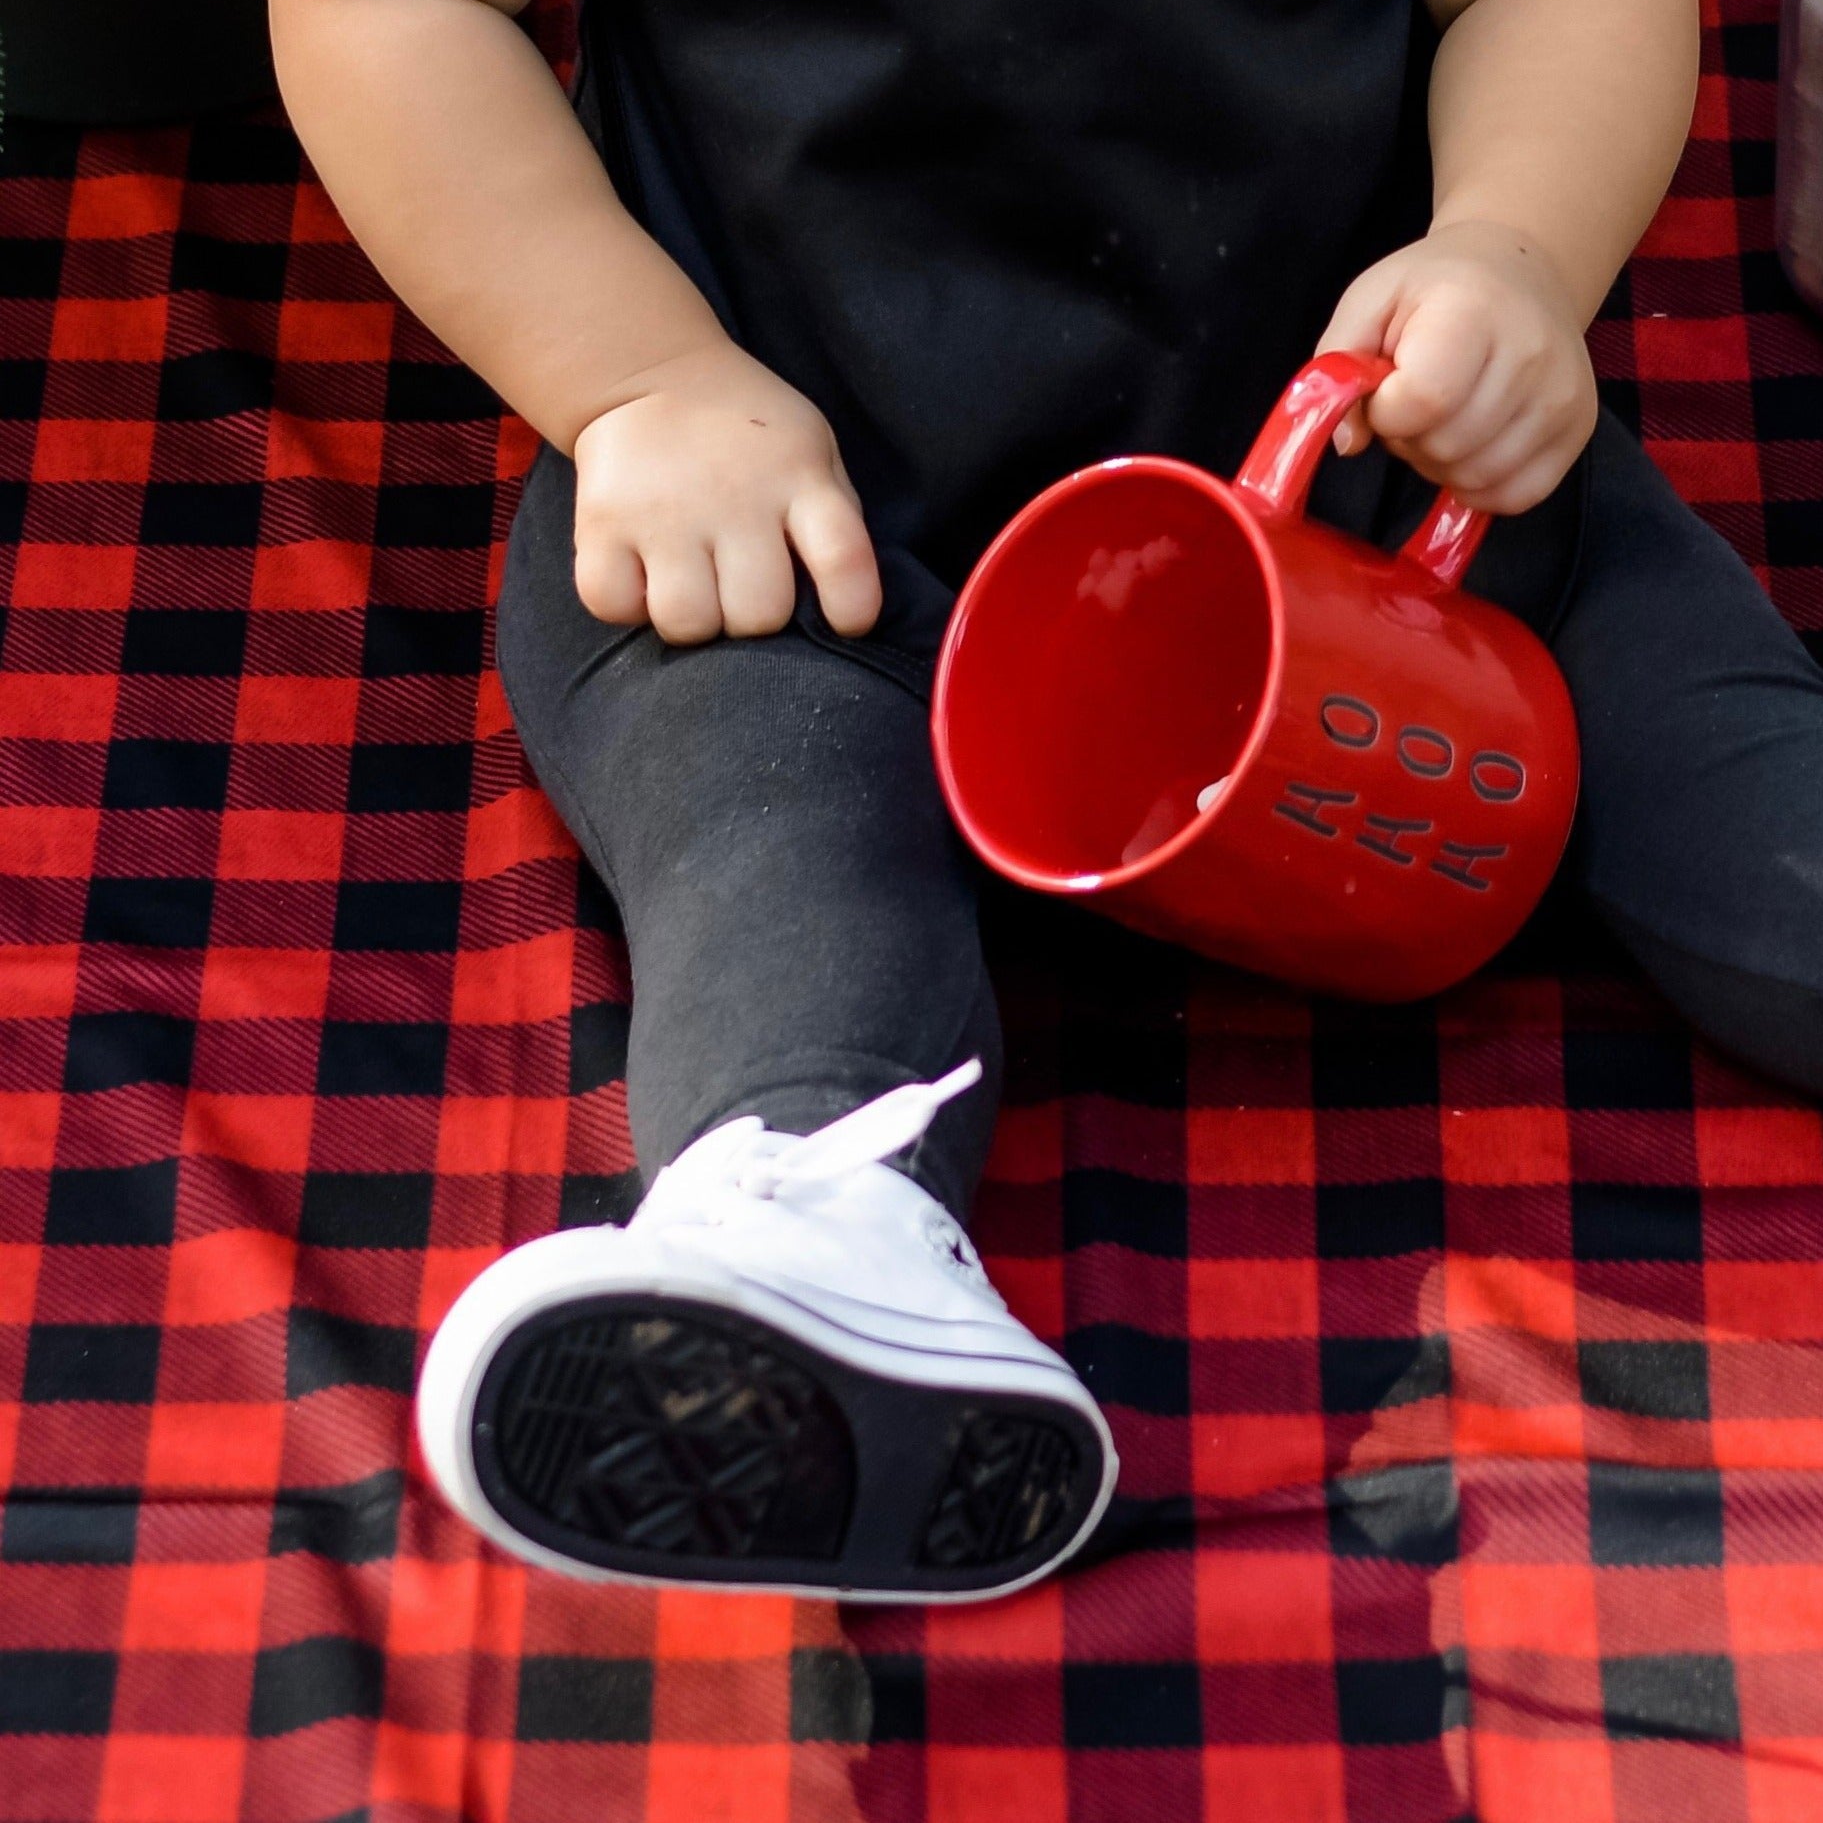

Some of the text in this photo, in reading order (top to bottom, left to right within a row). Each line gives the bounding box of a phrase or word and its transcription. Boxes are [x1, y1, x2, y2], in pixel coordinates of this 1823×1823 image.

[1273, 694, 1383, 839] HO
[1354, 724, 1457, 867] HO
[1430, 749, 1528, 892] HO
